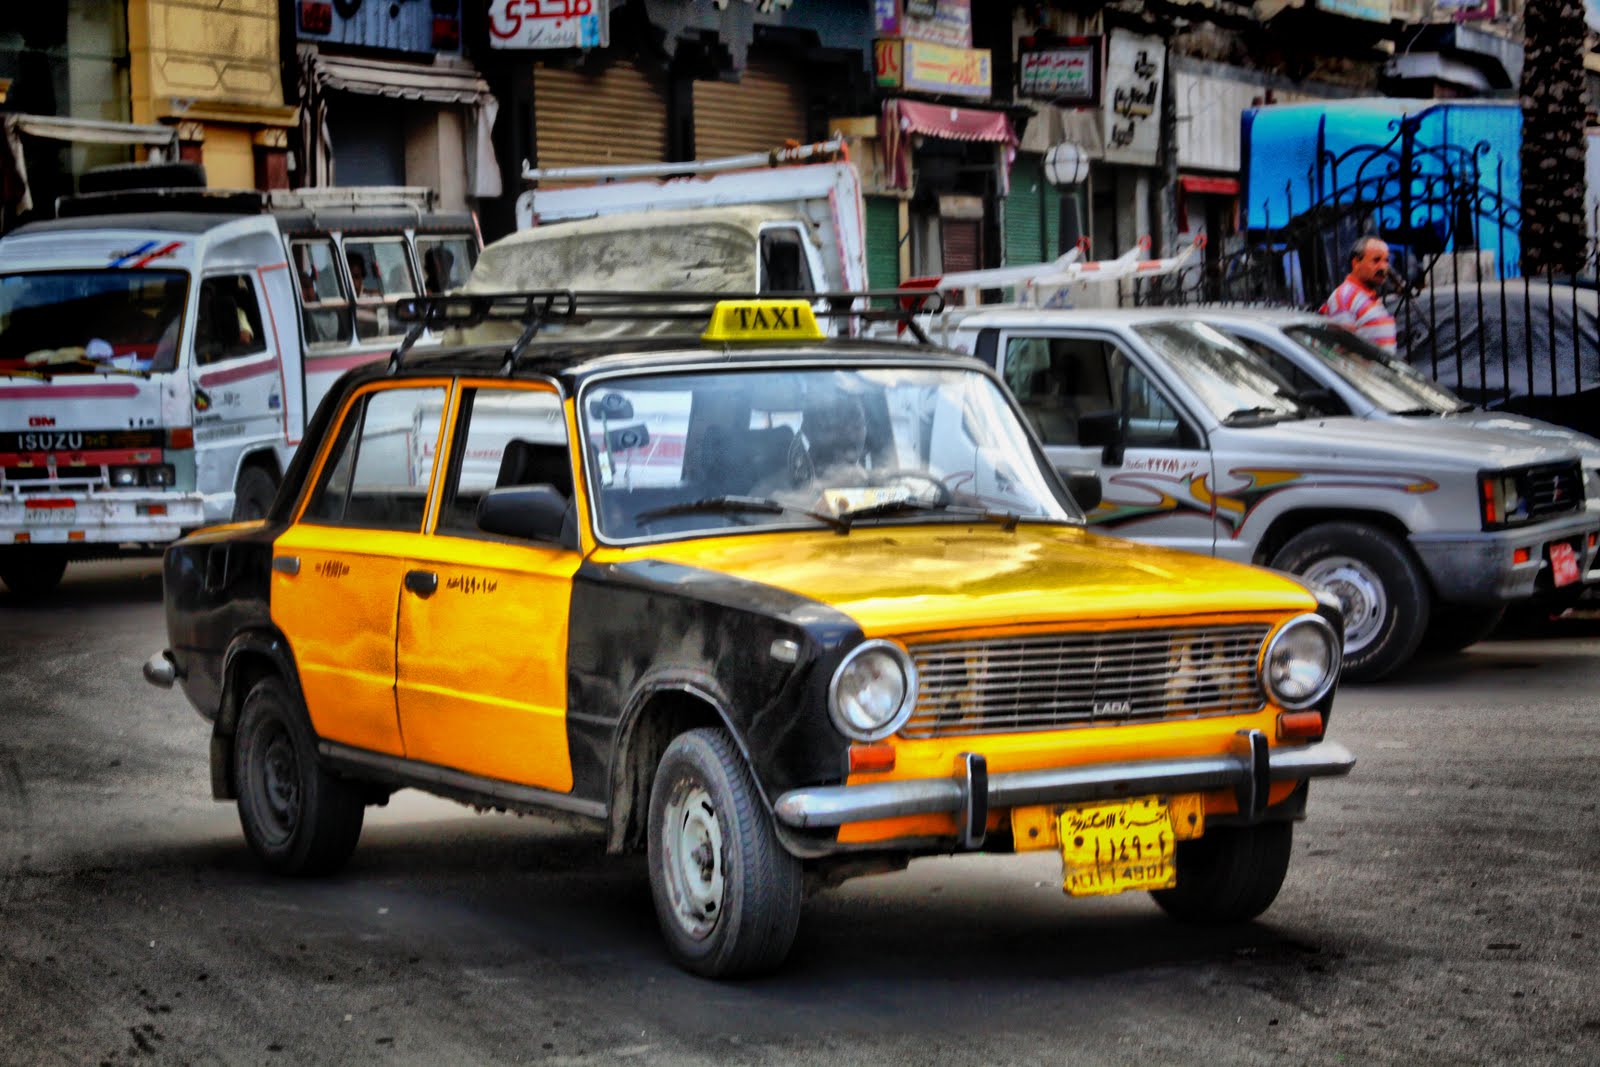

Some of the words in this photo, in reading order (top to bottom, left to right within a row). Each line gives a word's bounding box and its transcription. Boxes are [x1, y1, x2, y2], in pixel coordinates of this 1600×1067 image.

[734, 307, 801, 330] TAXI
[18, 433, 82, 450] ISUZU
[1093, 702, 1131, 716] LADA
